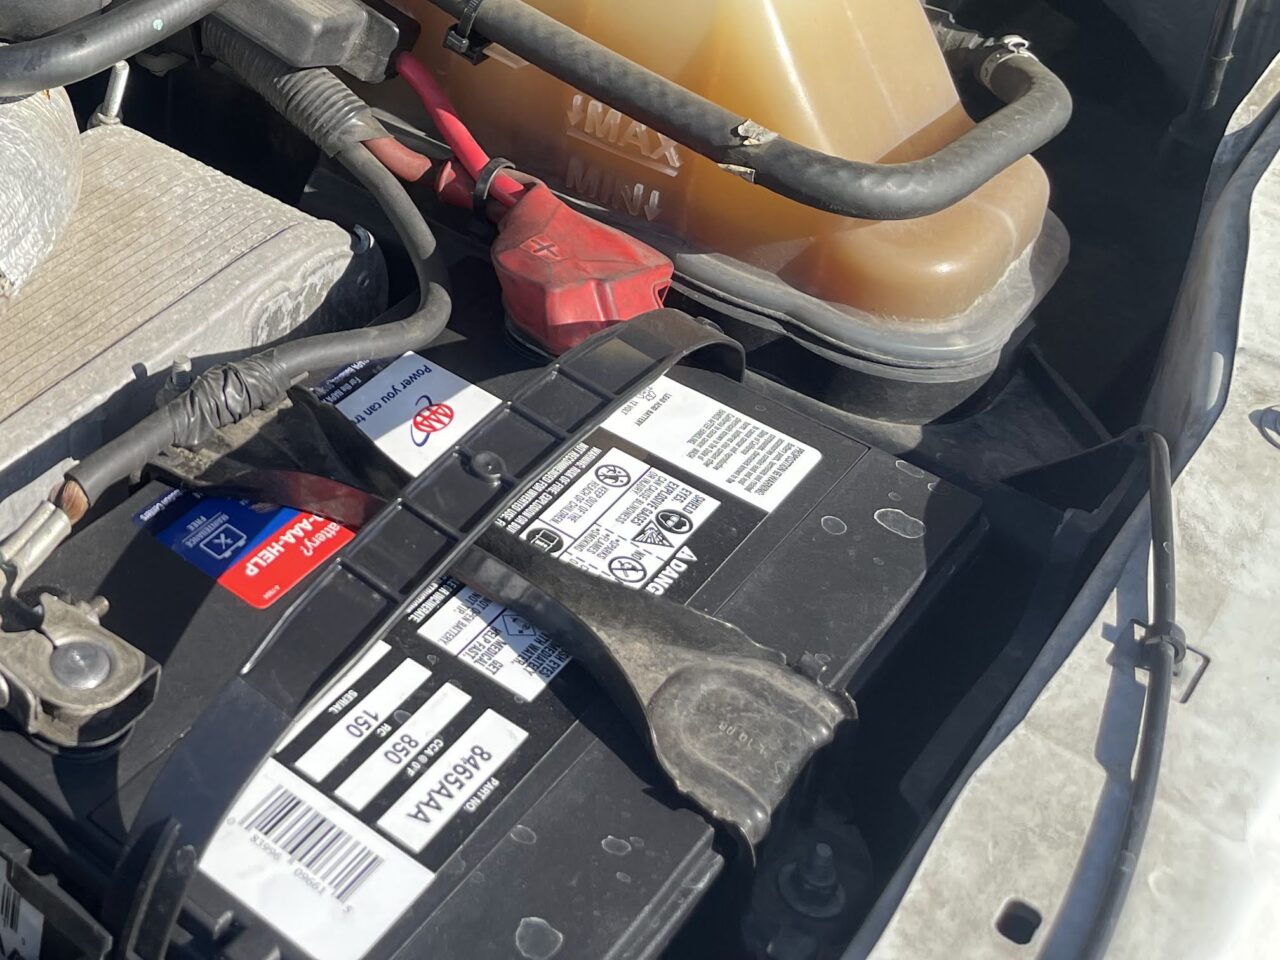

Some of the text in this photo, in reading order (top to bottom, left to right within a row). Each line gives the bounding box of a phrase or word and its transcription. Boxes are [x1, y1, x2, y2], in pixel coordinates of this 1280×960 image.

[584, 100, 680, 169] MAX
[566, 157, 644, 217] MIN
[397, 364, 433, 389] Power
[379, 385, 402, 403] you
[363, 401, 384, 416] can
[620, 404, 633, 415] VOLT
[634, 409, 653, 426] BATTERY
[557, 475, 571, 485] OF
[563, 465, 582, 479] RISK
[646, 471, 657, 479] OR
[531, 479, 548, 492] FOR
[578, 480, 600, 496] REACH
[671, 487, 692, 504] EYES.
[521, 491, 553, 519] EXPLOSION
[565, 485, 608, 523] KEEP OUT OF THE
[571, 494, 585, 503] OF
[614, 475, 666, 523] CAN CAUSE BLINDNESS
[629, 481, 678, 526] EXPLOSIVE GASES
[681, 494, 705, 514] SHIELD
[183, 513, 230, 548] MAINTENANCE
[185, 515, 208, 531] FREE
[514, 513, 528, 526] OR
[293, 522, 341, 556] attery?
[630, 549, 644, 560] NO
[644, 558, 688, 597] DANG
[464, 591, 481, 605] NOT
[437, 597, 493, 645] NOT OPEN BATTERY.
[461, 625, 501, 661] HELP FAST.
[472, 638, 507, 668] MEDICAL
[510, 642, 540, 668] WATER.
[521, 641, 559, 676] MEDIATELY
[484, 659, 503, 675] GET
[537, 659, 559, 678] EYES
[327, 688, 358, 715] SERIAL
[343, 706, 382, 739] 150
[373, 722, 391, 737] RC
[381, 732, 420, 766] 850
[423, 737, 444, 756] CCA
[405, 742, 493, 828] 8465AAA
[475, 776, 500, 800] PART
